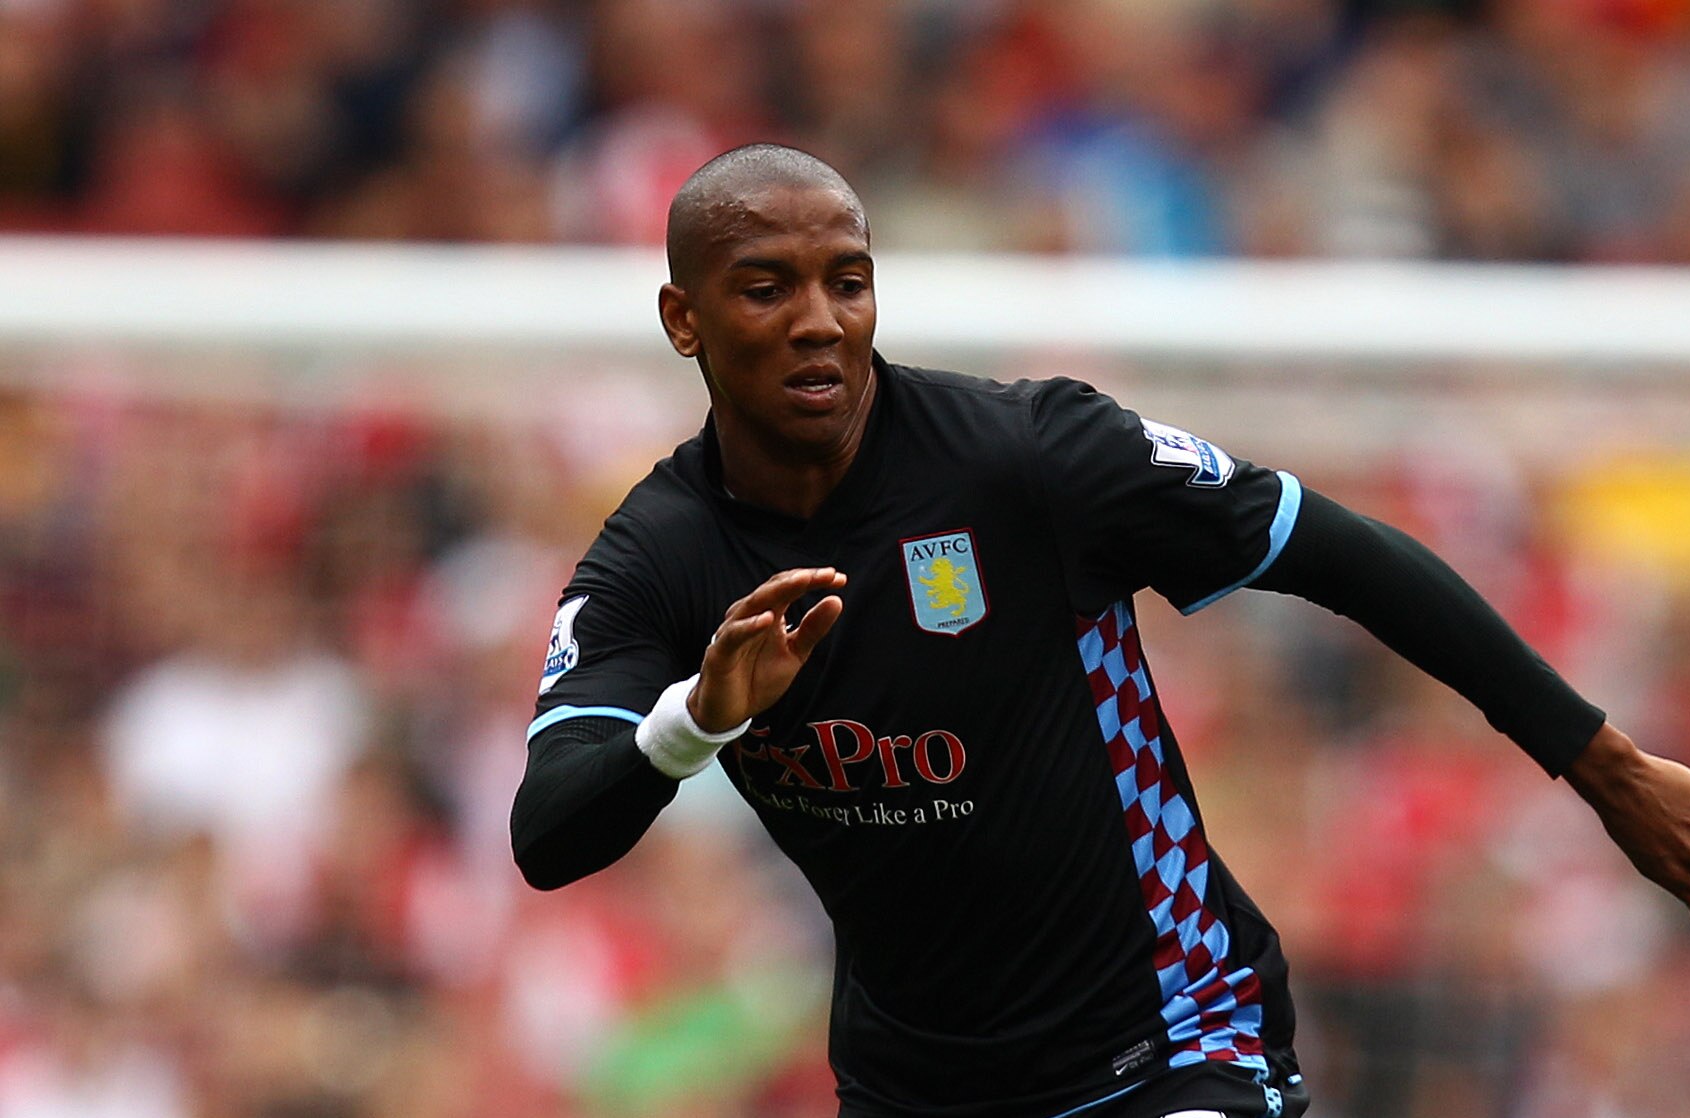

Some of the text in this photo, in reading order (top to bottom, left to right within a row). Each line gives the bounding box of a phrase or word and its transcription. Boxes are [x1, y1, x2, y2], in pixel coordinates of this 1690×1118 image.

[910, 537, 968, 562] AVFC
[855, 802, 906, 825] Like
[914, 807, 926, 823] a
[934, 799, 974, 821] Pro
